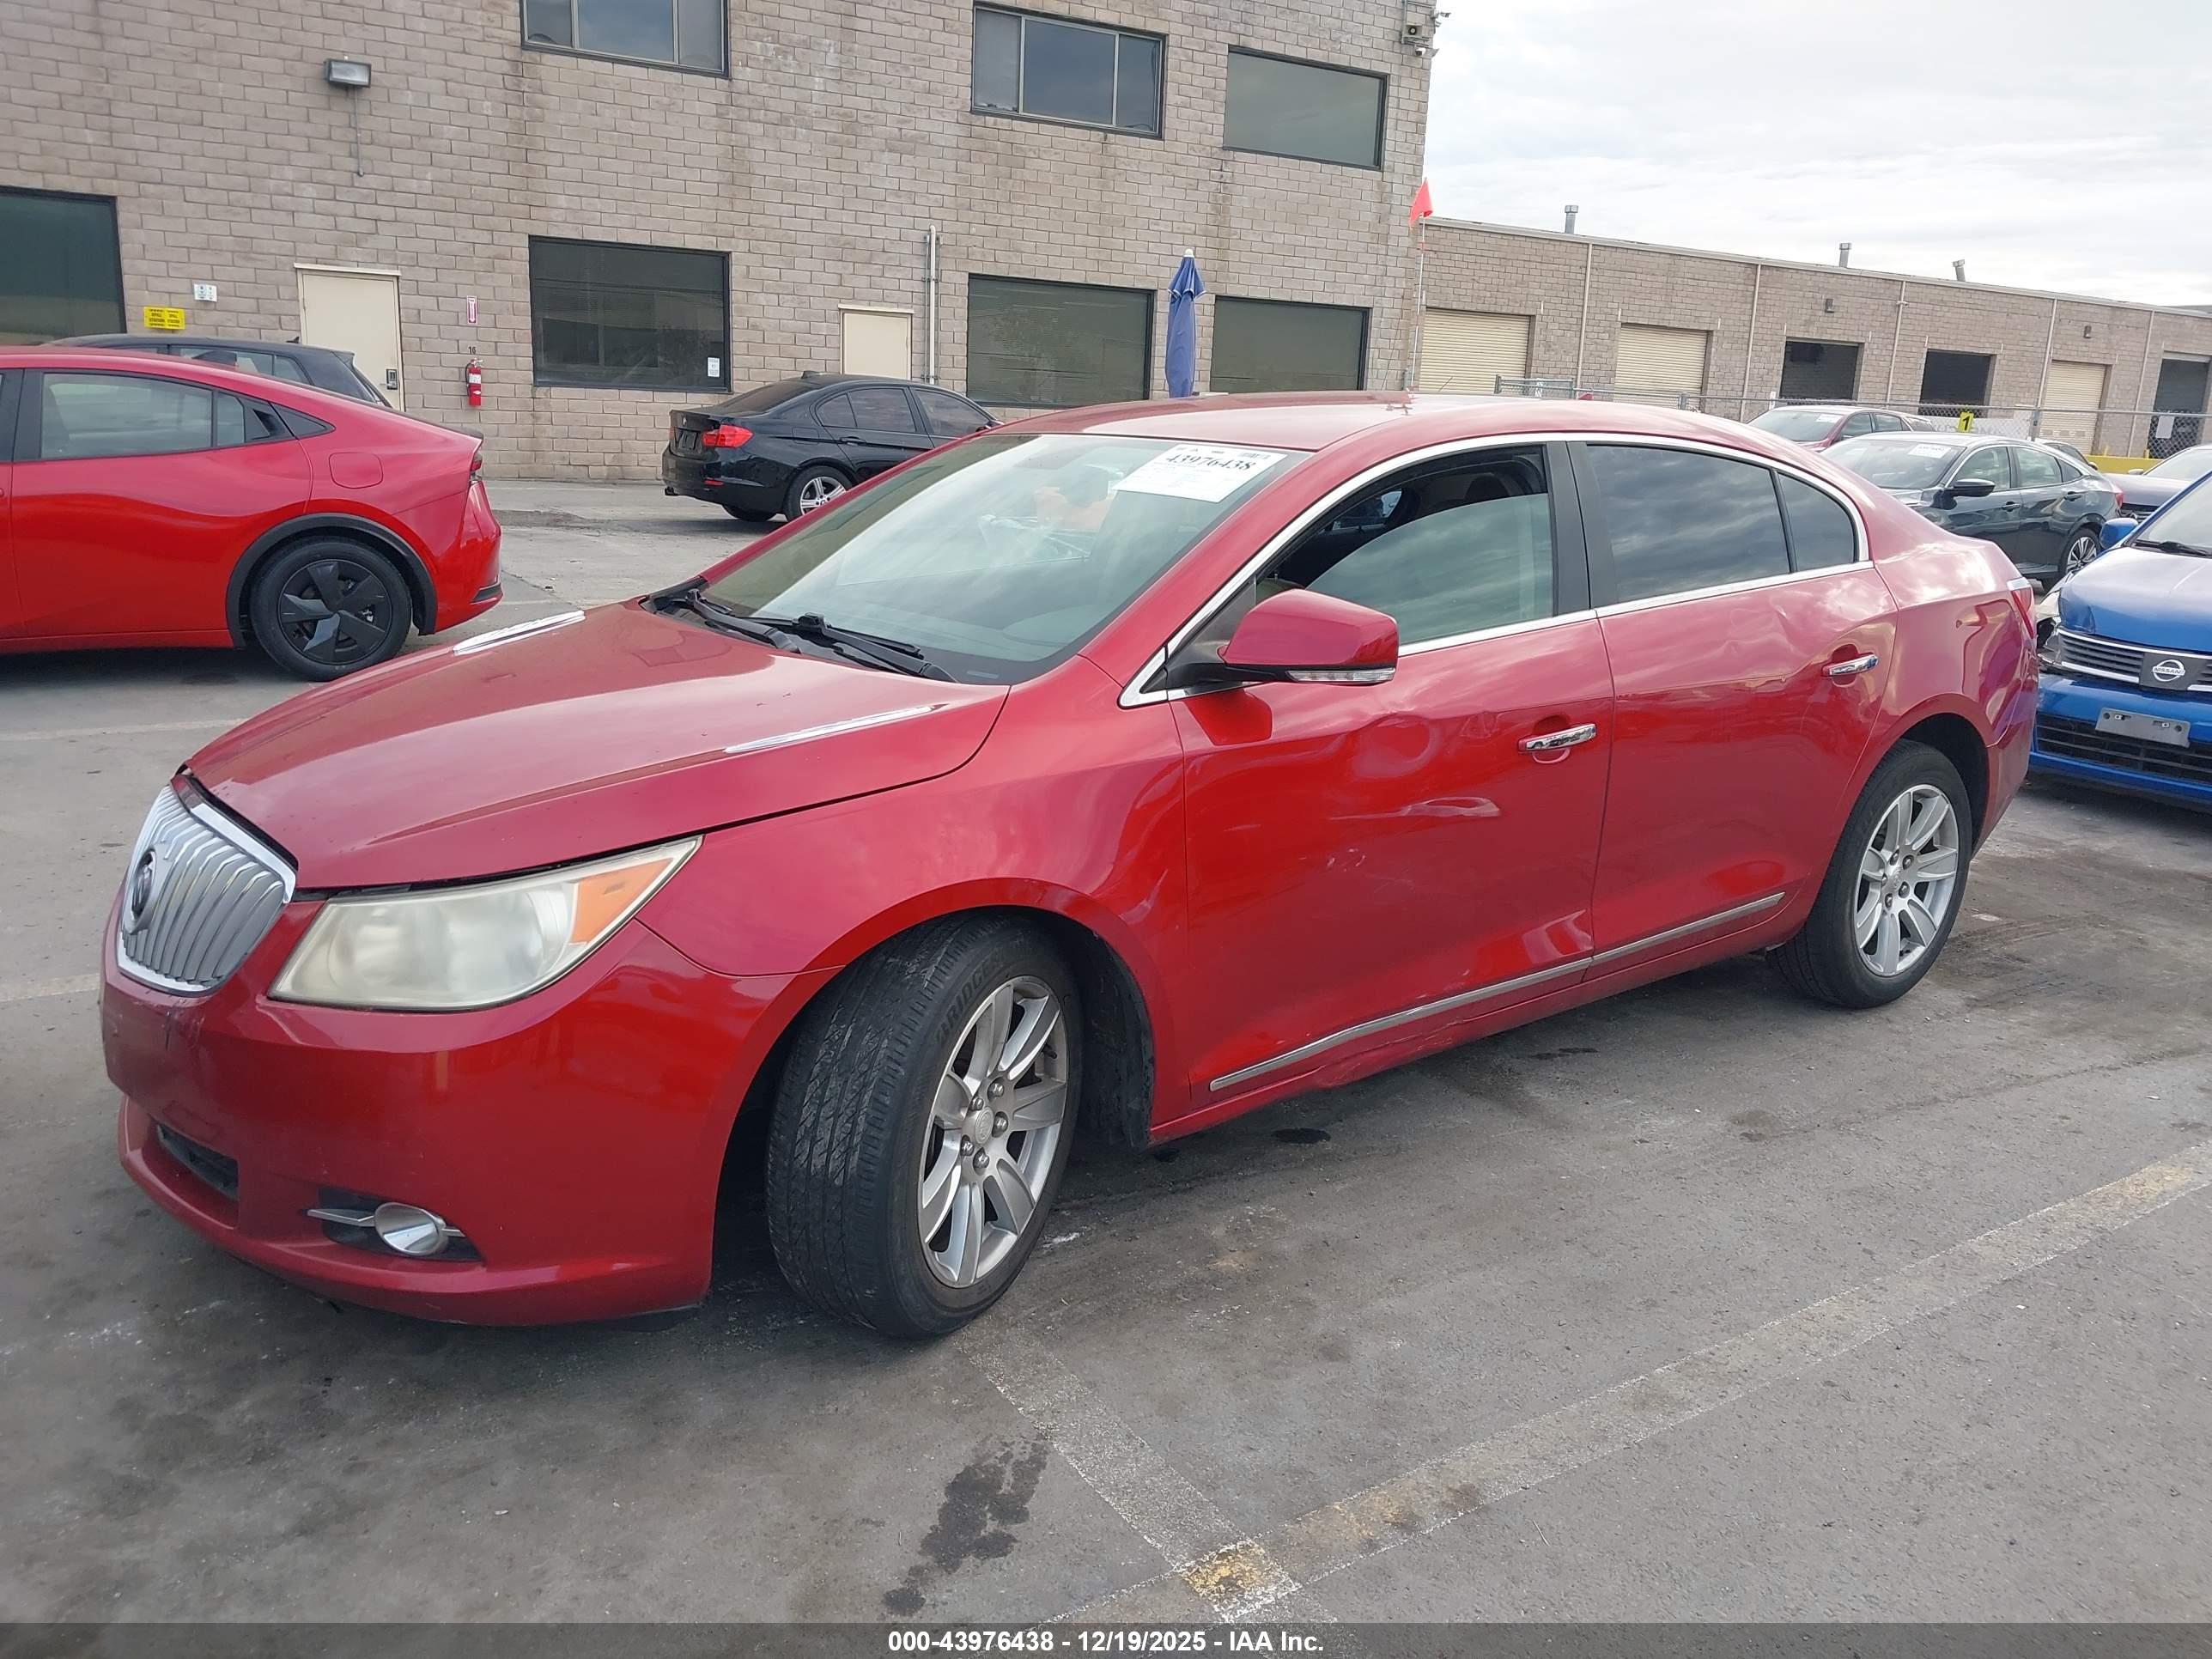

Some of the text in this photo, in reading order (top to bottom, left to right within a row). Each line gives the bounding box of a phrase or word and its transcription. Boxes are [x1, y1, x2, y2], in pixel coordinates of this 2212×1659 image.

[468, 346, 477, 355] 16
[1962, 415, 1971, 431] 1
[1165, 453, 1256, 471] 43976438
